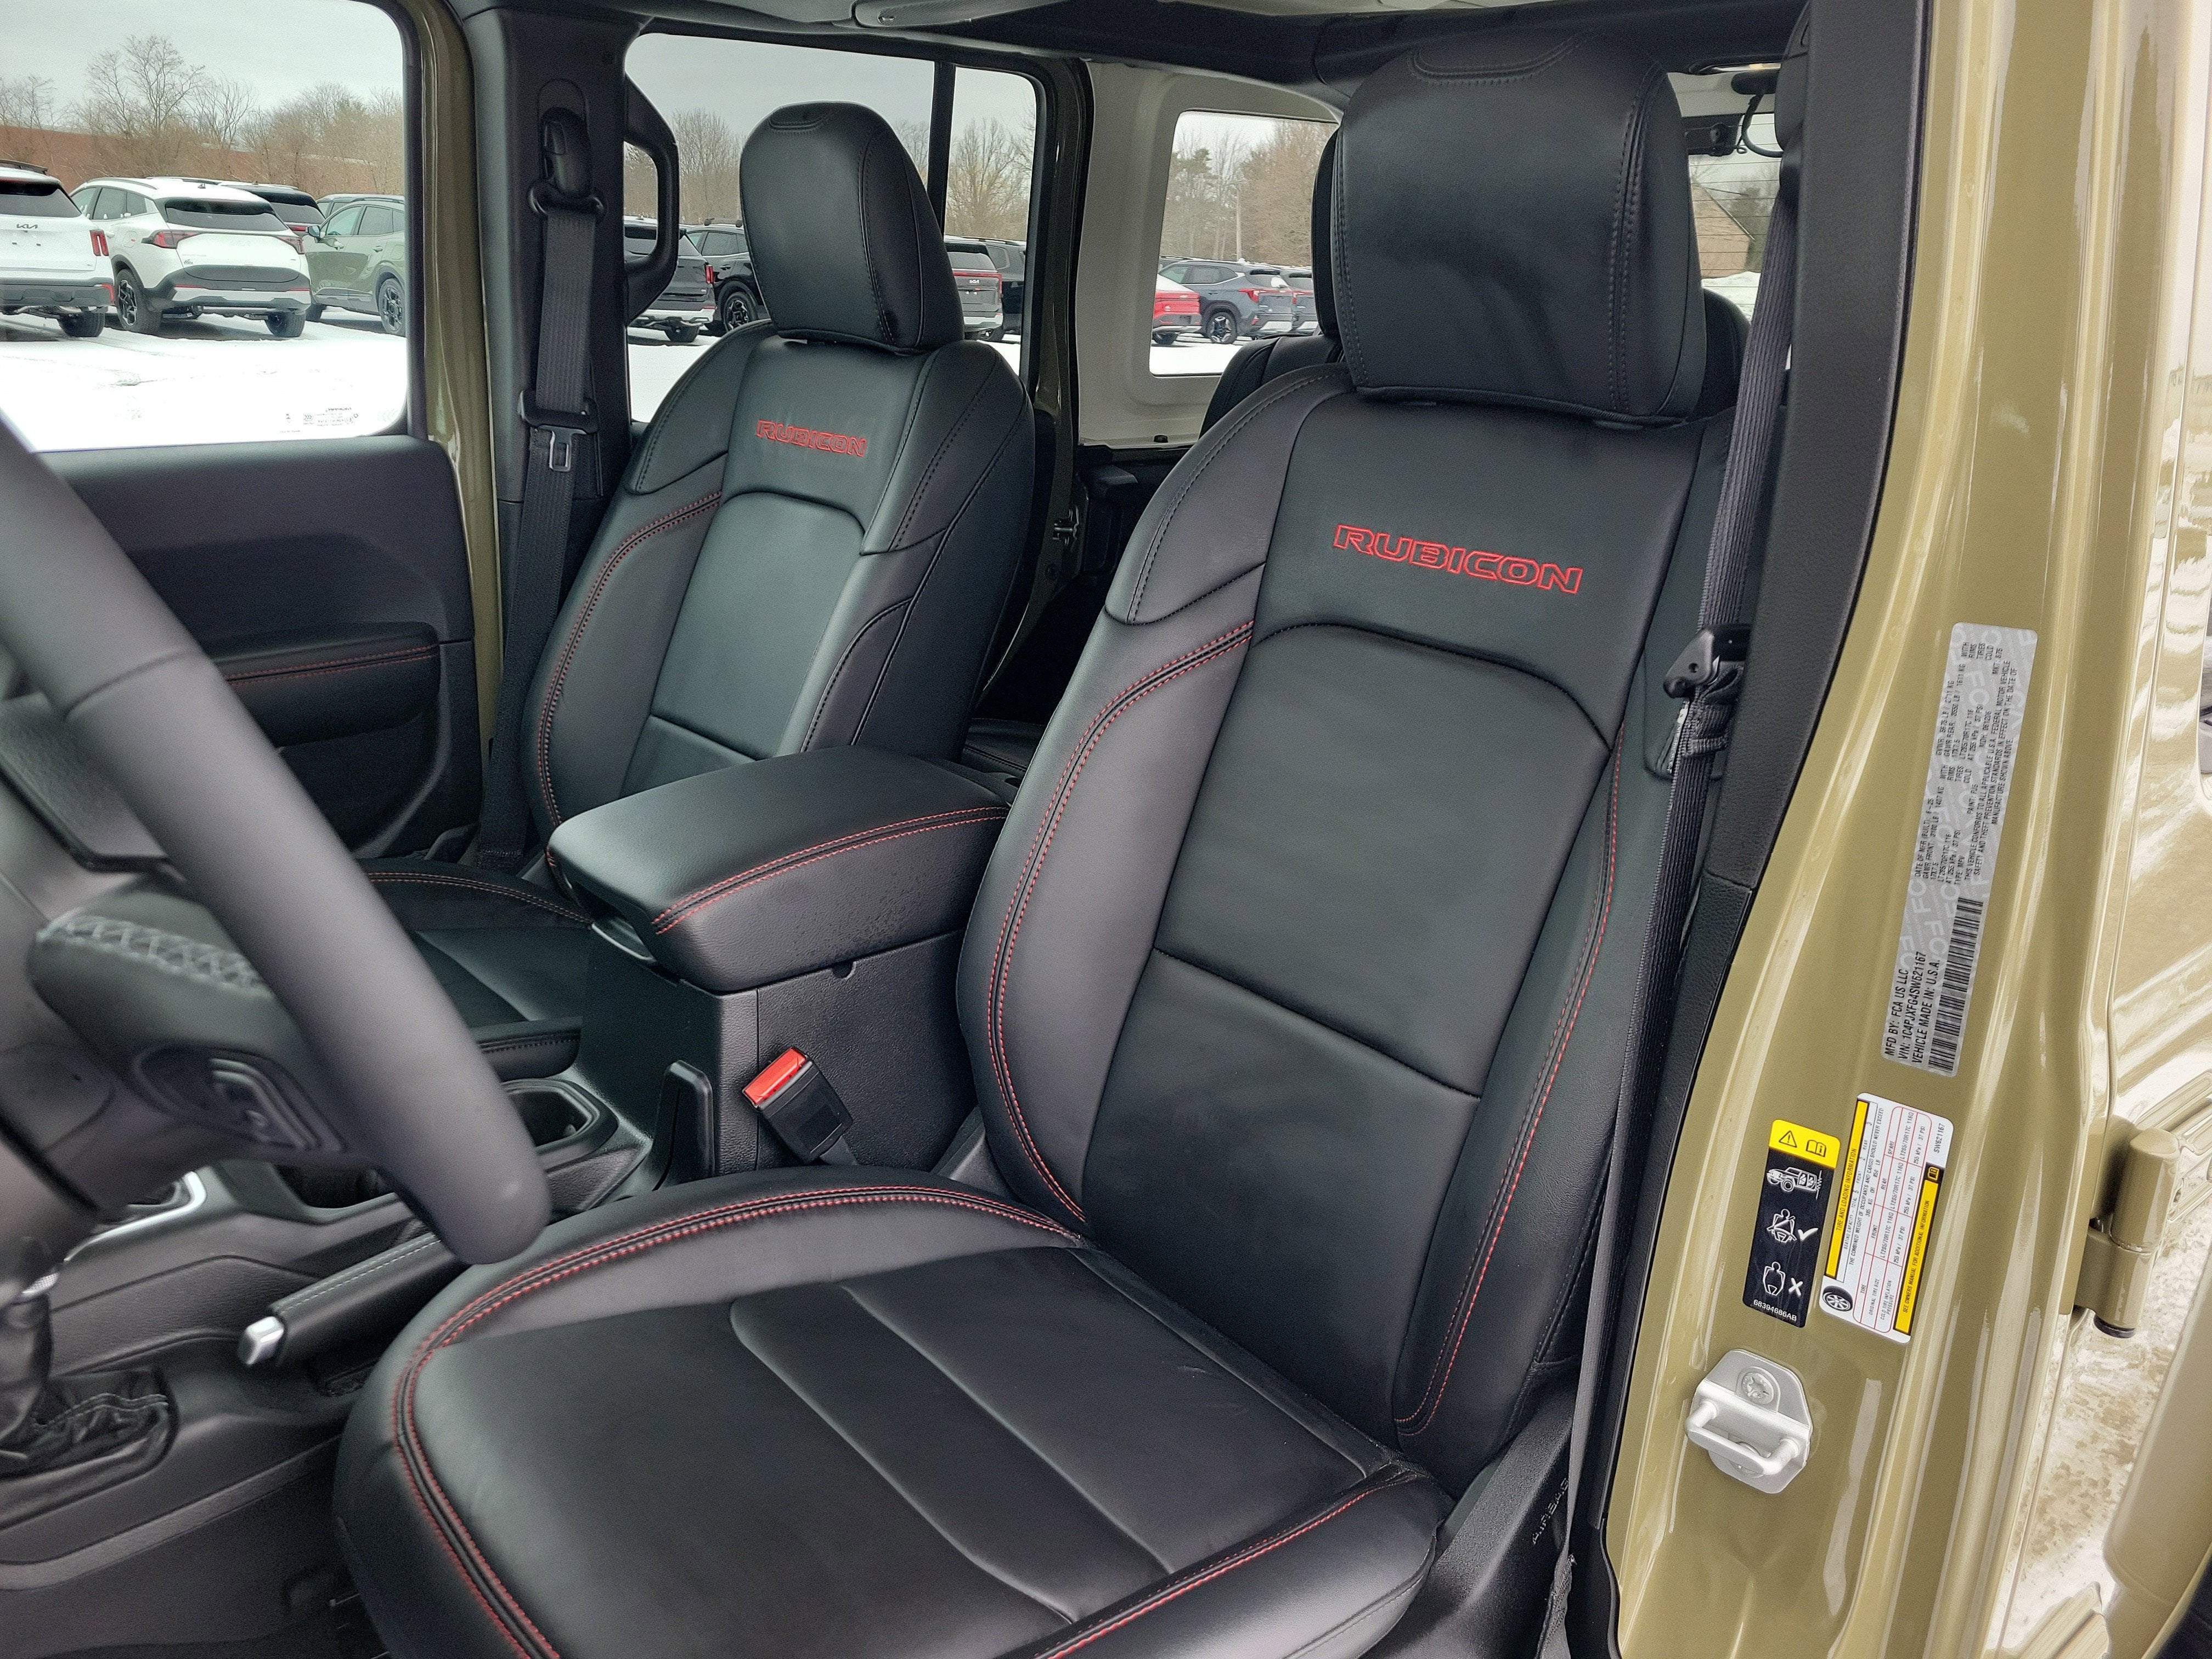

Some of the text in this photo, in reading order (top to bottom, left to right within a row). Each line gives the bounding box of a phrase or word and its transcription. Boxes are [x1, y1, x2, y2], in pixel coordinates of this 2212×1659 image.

[756, 419, 867, 457] RUBICON
[1332, 523, 1583, 594] RUBICON
[1961, 641, 1969, 657] WITH
[1968, 643, 1977, 658] RIMS
[1976, 642, 1985, 659] TIRES
[1985, 645, 1994, 660] COLD
[1999, 660, 2010, 684] VEHICLE
[2010, 667, 2017, 675] OF
[1946, 680, 1954, 688] KG
[2006, 676, 2016, 692] DATE
[1995, 686, 2005, 706] MOTOR
[2004, 693, 2012, 706] THE
[1944, 740, 1953, 757] GAWR
[1958, 663, 1965, 672] KG
[2002, 707, 2010, 716] ON
[1990, 708, 2001, 734] FEDERAL
[1998, 718, 2008, 739] EFFECT
[1940, 764, 1948, 779] WITH
[1947, 765, 1955, 781] RIMS
[1955, 765, 1963, 782] TIRES
[1963, 768, 1972, 783] COLD
[1980, 755, 1993, 789] APPLICABLE
[1990, 748, 2003, 783] STANDARDS
[1984, 783, 1996, 820] PREVENTION
[1991, 782, 2005, 824] MANUFACTURE
[1999, 759, 2009, 781] SHOWN
[1922, 862, 1931, 879] GAWR
[1937, 786, 1944, 794] KG
[1971, 811, 1983, 843] CONFORMS
[1980, 821, 1989, 839] THEFT
[1967, 844, 1977, 866] VEHICLE
[1978, 840, 1986, 853] AND
[1915, 862, 1923, 877] DATE
[1957, 855, 1965, 867] MPV
[1973, 854, 1983, 875] SAFETY
[1965, 867, 1973, 881] THIS
[1884, 968, 1908, 1056] MFD BY: FCA US LLC
[1898, 951, 1926, 1060] VIN: 1C4PJXFG4SW621167
[1912, 958, 1940, 1064] VEHICLE MADE IN: U.S.A.
[1933, 1122, 1945, 1153] SW621167
[1845, 1147, 1857, 1183] INFORMATION
[1841, 1183, 1850, 1207] LOADING
[1850, 1234, 1859, 1256] COMBINED
[1860, 1183, 1869, 1210] OCCUPANTS
[1904, 1285, 1912, 1304] OWNERS
[1914, 1231, 1923, 1256] ADDITIONAL
[1919, 1199, 1929, 1229] INFORMATION
[1753, 1299, 1797, 1321] 68394686AB
[1886, 1294, 1894, 1315] PRESSURE
